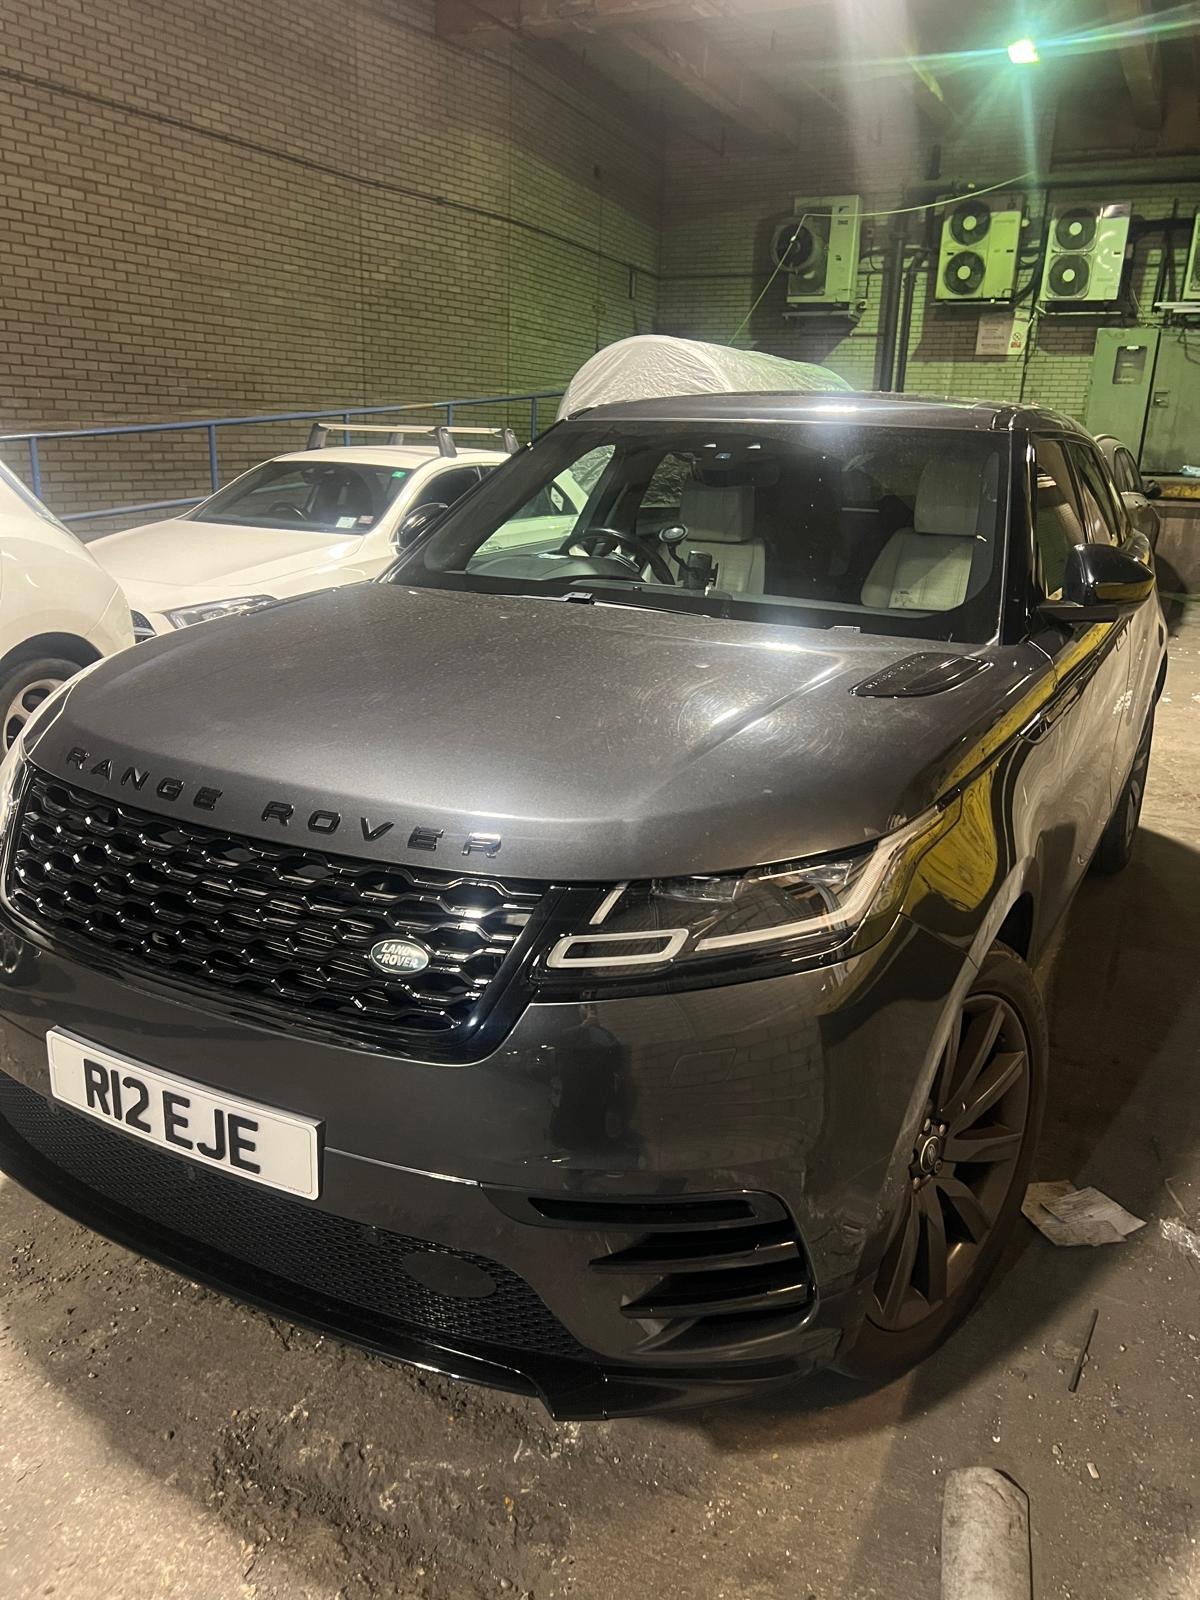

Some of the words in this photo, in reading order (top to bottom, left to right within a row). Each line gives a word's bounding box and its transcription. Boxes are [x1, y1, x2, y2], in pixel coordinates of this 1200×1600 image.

[66, 747, 223, 811] RANGE
[261, 800, 502, 859] ROVER
[380, 953, 419, 969] ROVER
[381, 942, 412, 957] LAND
[83, 1058, 152, 1134] R12
[162, 1090, 261, 1175] EJE
